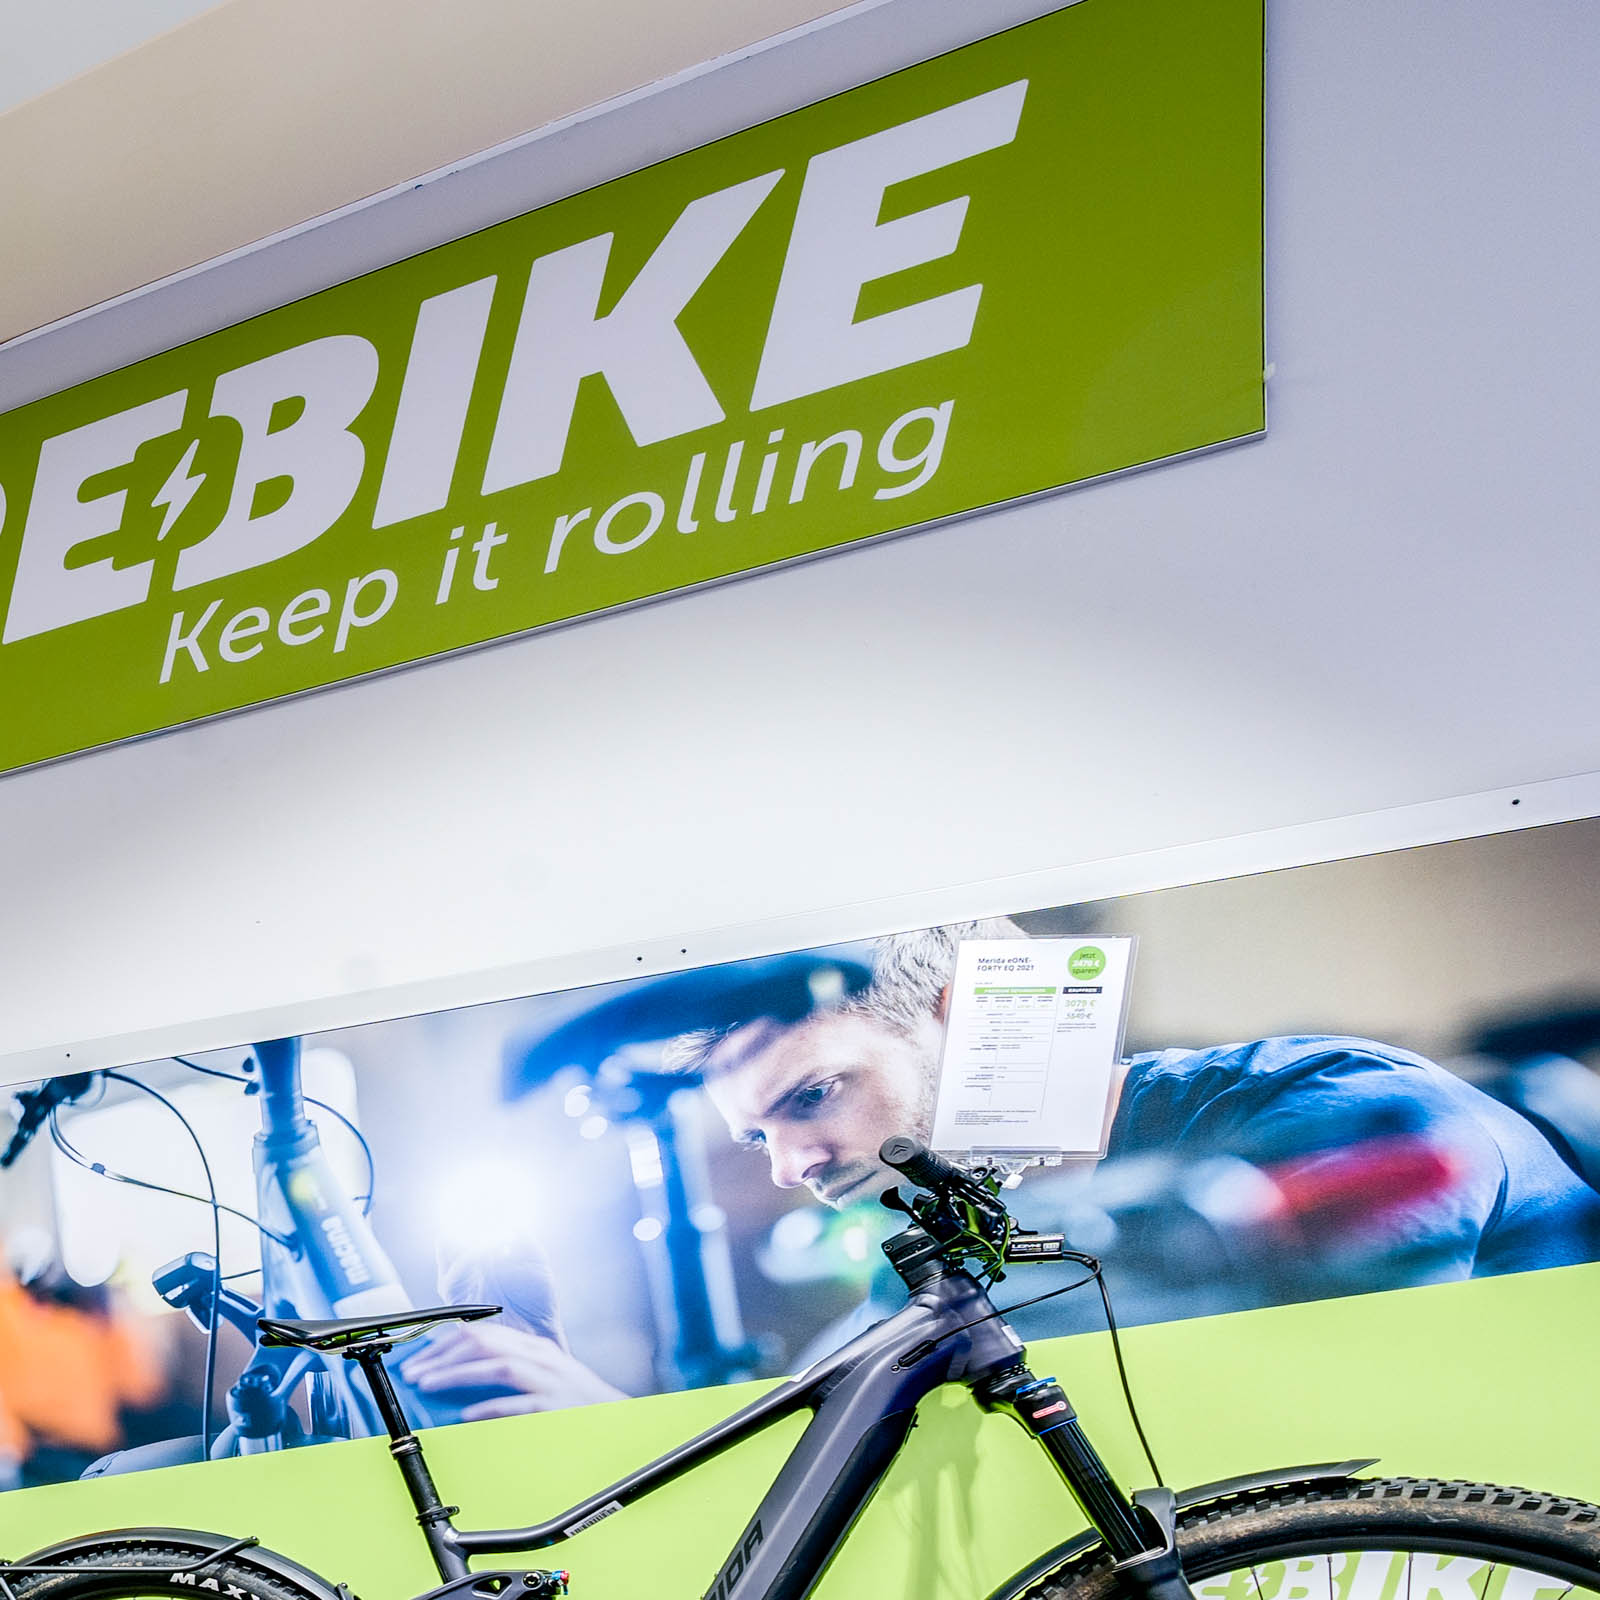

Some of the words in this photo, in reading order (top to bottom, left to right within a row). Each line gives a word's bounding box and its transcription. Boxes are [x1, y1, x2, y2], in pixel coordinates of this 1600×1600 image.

[159, 565, 399, 685] Keep
[435, 525, 500, 605] it
[544, 400, 955, 578] rolling
